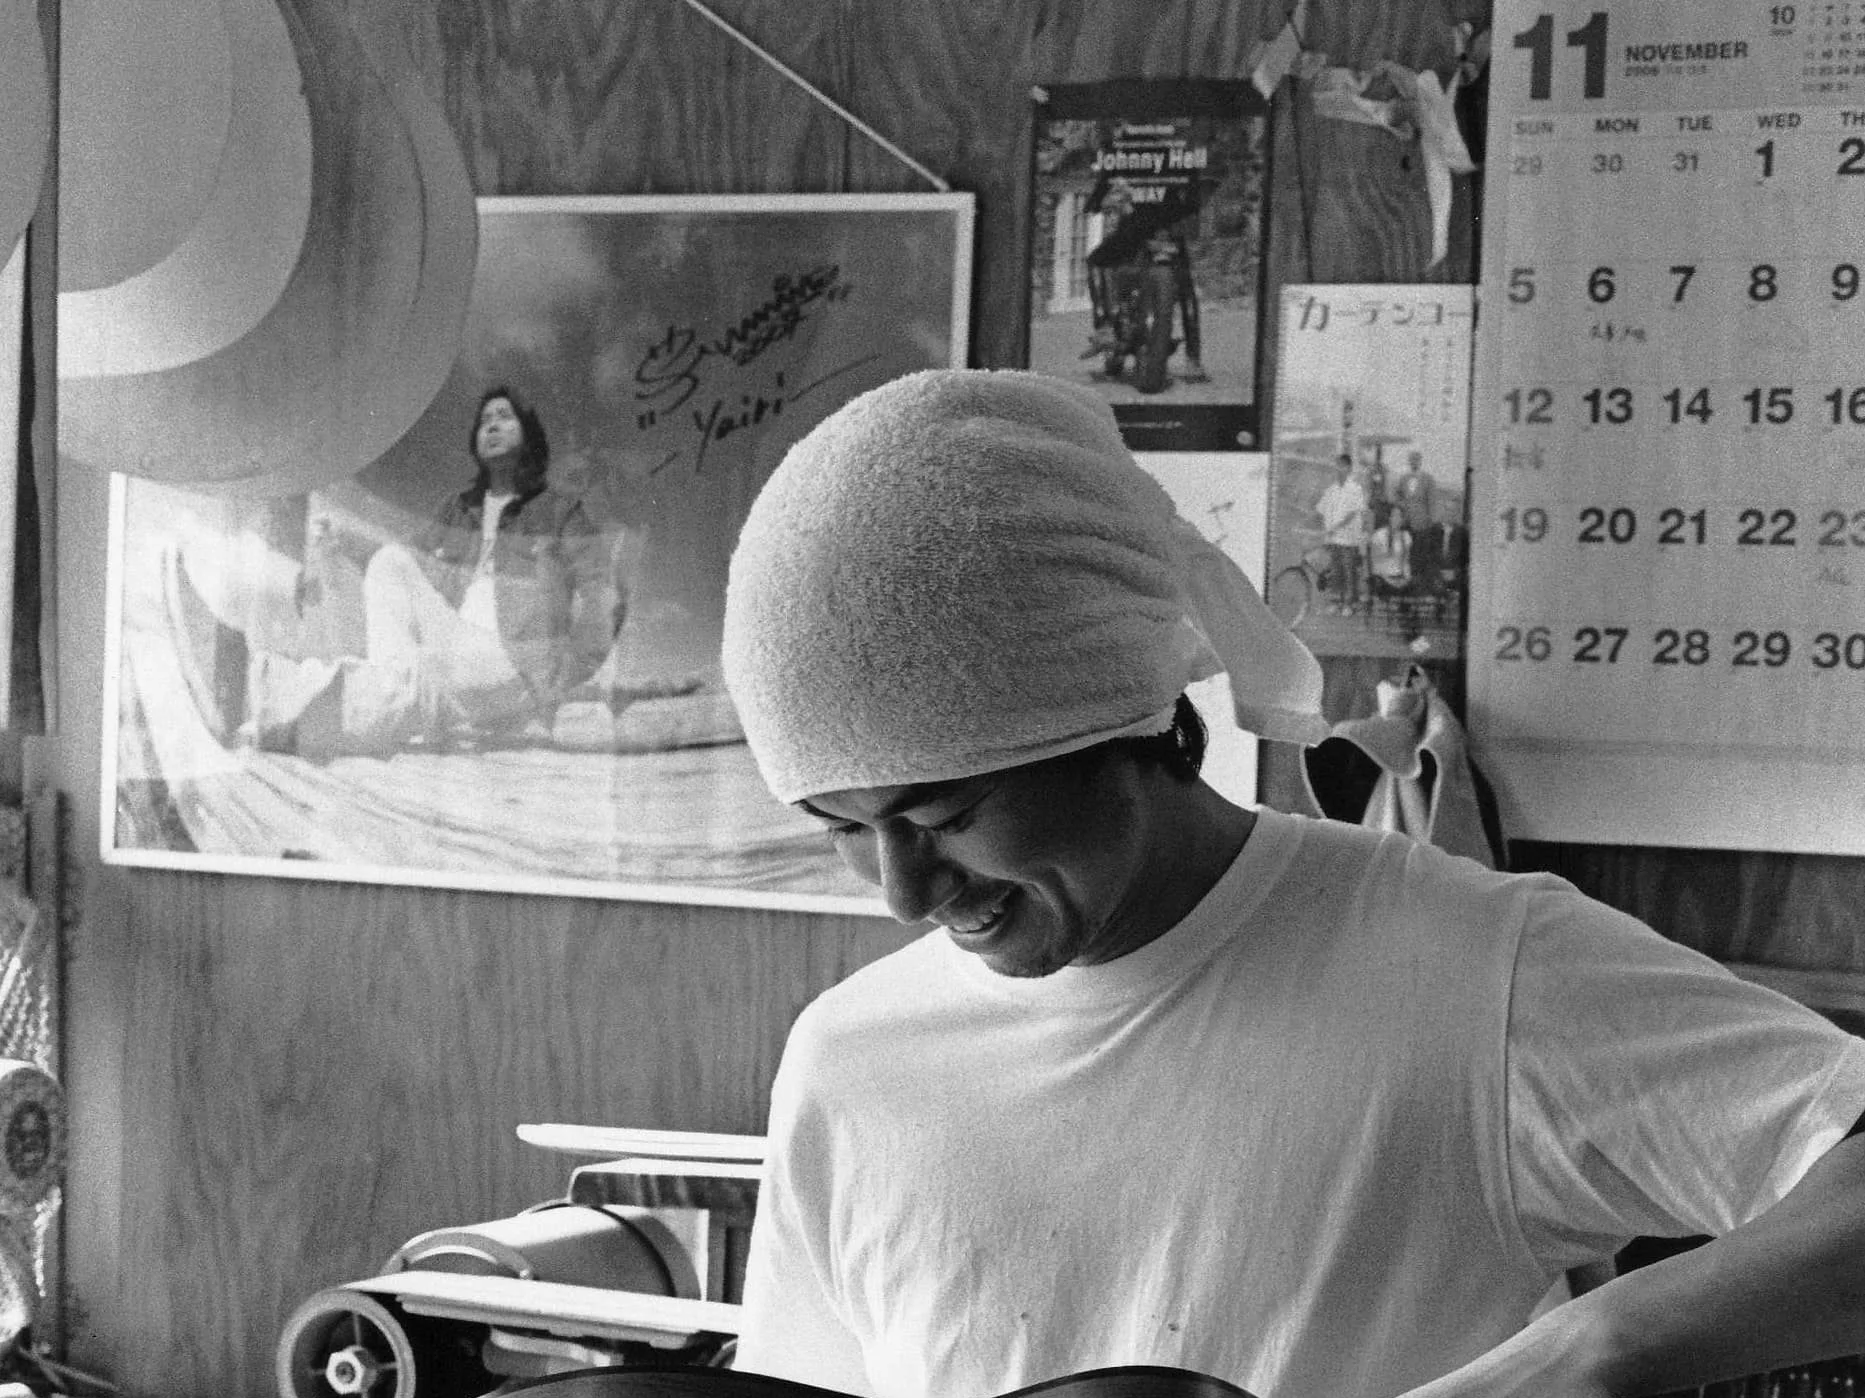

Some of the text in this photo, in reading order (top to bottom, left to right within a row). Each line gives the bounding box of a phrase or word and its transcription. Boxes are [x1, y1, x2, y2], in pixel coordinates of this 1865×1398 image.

[1769, 5, 1796, 25] 10
[1513, 11, 1609, 100] 11
[1625, 41, 1748, 62] NOVEMBER
[1516, 121, 1553, 135] SUN
[1595, 118, 1639, 132] MON
[1677, 115, 1713, 131] TUE
[1757, 112, 1801, 129] WED
[1091, 148, 1165, 173] Johnny
[1592, 153, 1624, 174] 30
[1674, 151, 1699, 172] 31
[1755, 140, 1774, 177] 1
[1837, 137, 1865, 176] 2
[1507, 263, 1860, 304] 5 6 7 8 9
[1503, 387, 1865, 425] 12 13 14 15 16
[1502, 507, 1550, 543] 19
[1578, 507, 1637, 544] 20
[1657, 508, 1706, 545] 21
[1737, 508, 1797, 546] 22
[1496, 625, 1865, 670] 26 27 28 29 30
